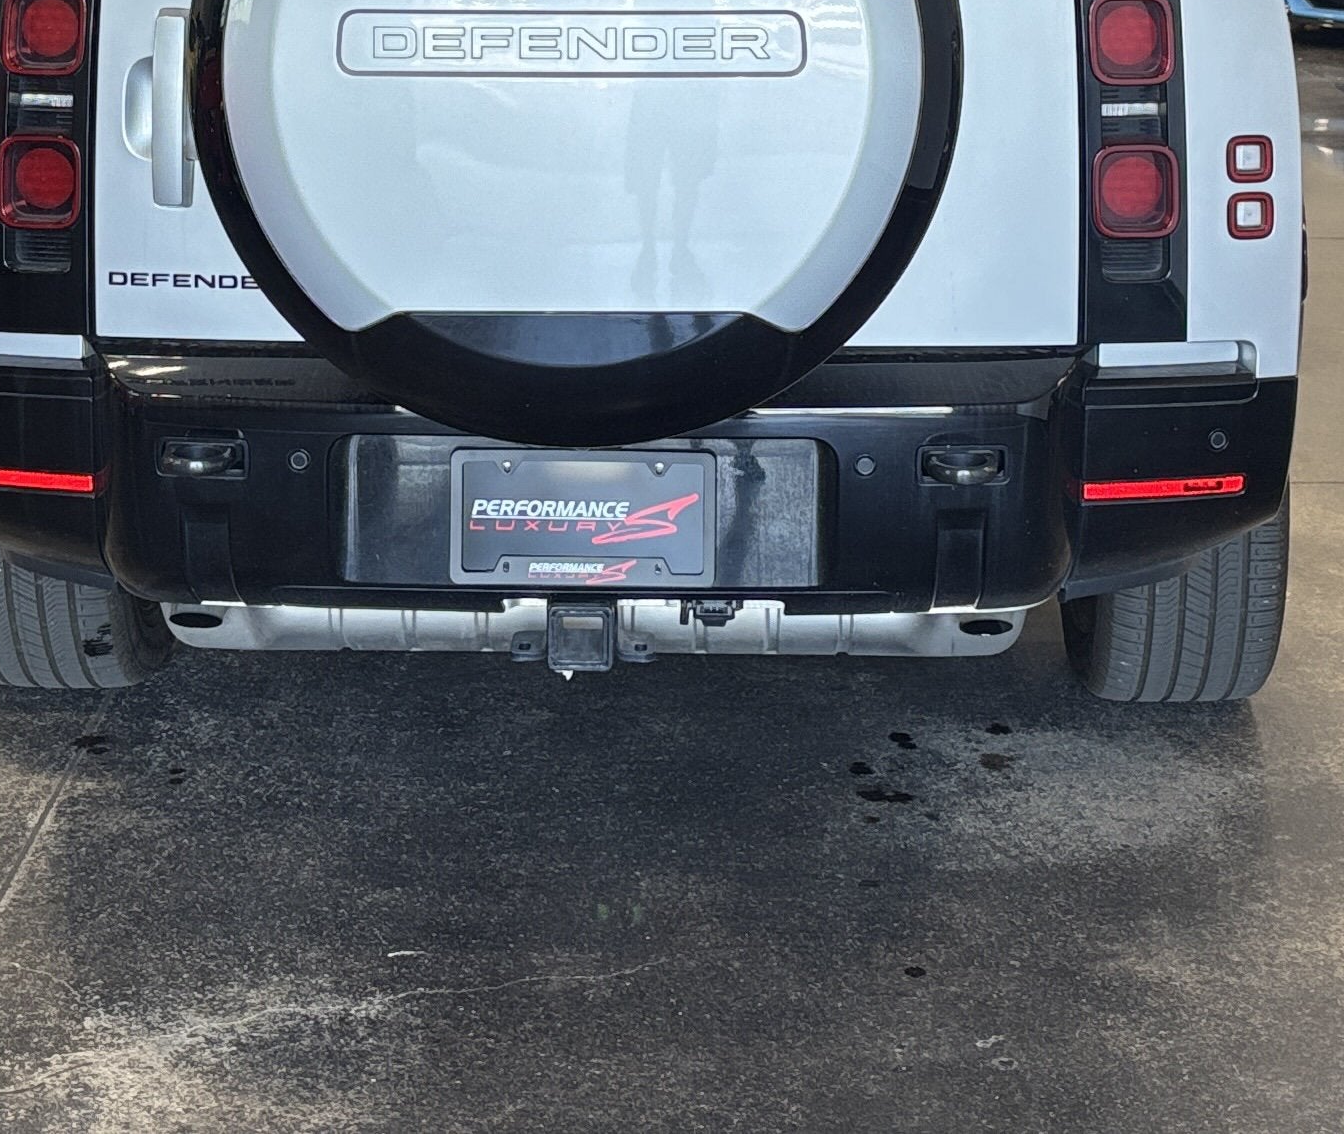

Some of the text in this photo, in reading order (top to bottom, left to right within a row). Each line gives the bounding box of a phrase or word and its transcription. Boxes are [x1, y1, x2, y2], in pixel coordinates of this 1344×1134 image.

[372, 25, 771, 60] DEFENDER
[108, 271, 261, 290] DEFENDE
[471, 499, 631, 518] PERFORMANCE
[528, 562, 605, 573] PERFORMANCE
